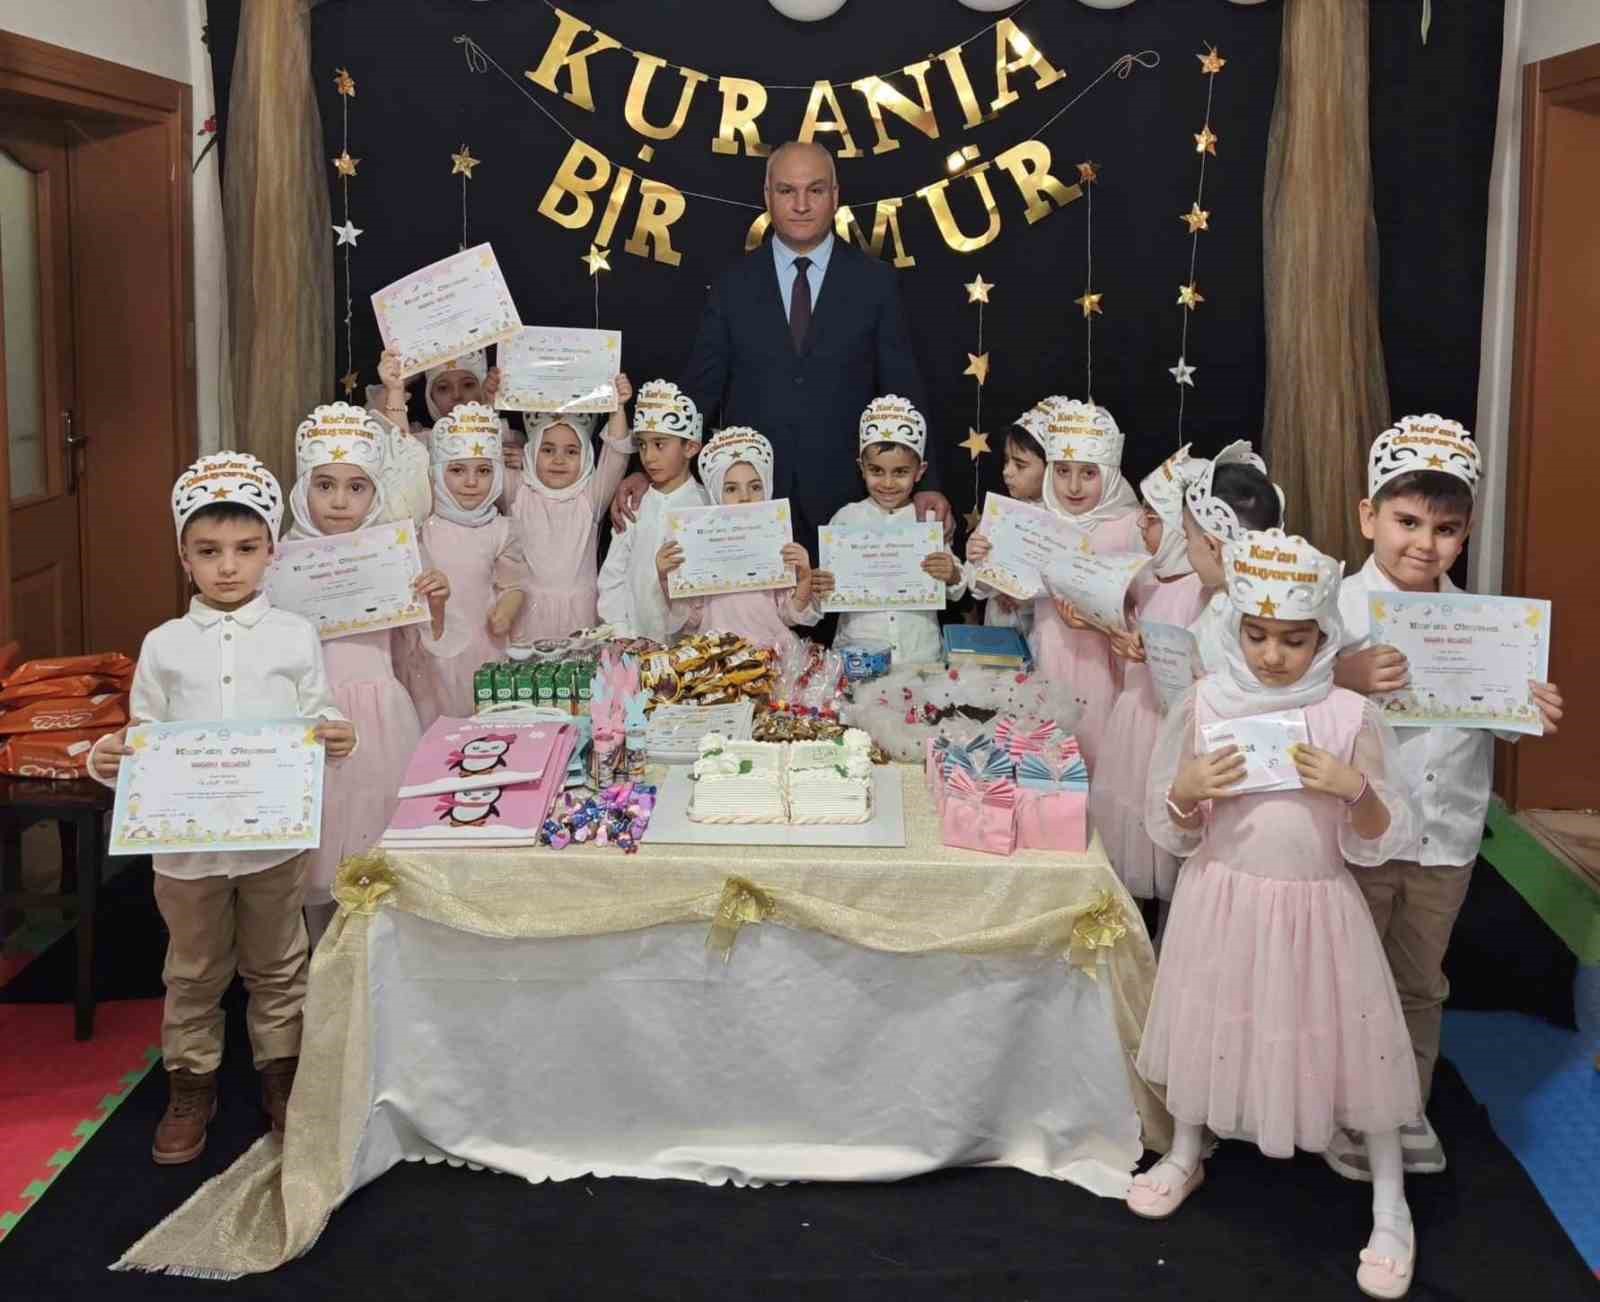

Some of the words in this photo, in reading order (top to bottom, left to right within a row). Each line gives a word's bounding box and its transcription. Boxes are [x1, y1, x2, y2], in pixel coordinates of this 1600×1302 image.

[744, 139, 1083, 268] MÜR
[1410, 423, 1457, 438] Kur'an
[1249, 544, 1297, 565] Kur'an
[1233, 559, 1319, 583] Okuyorum
